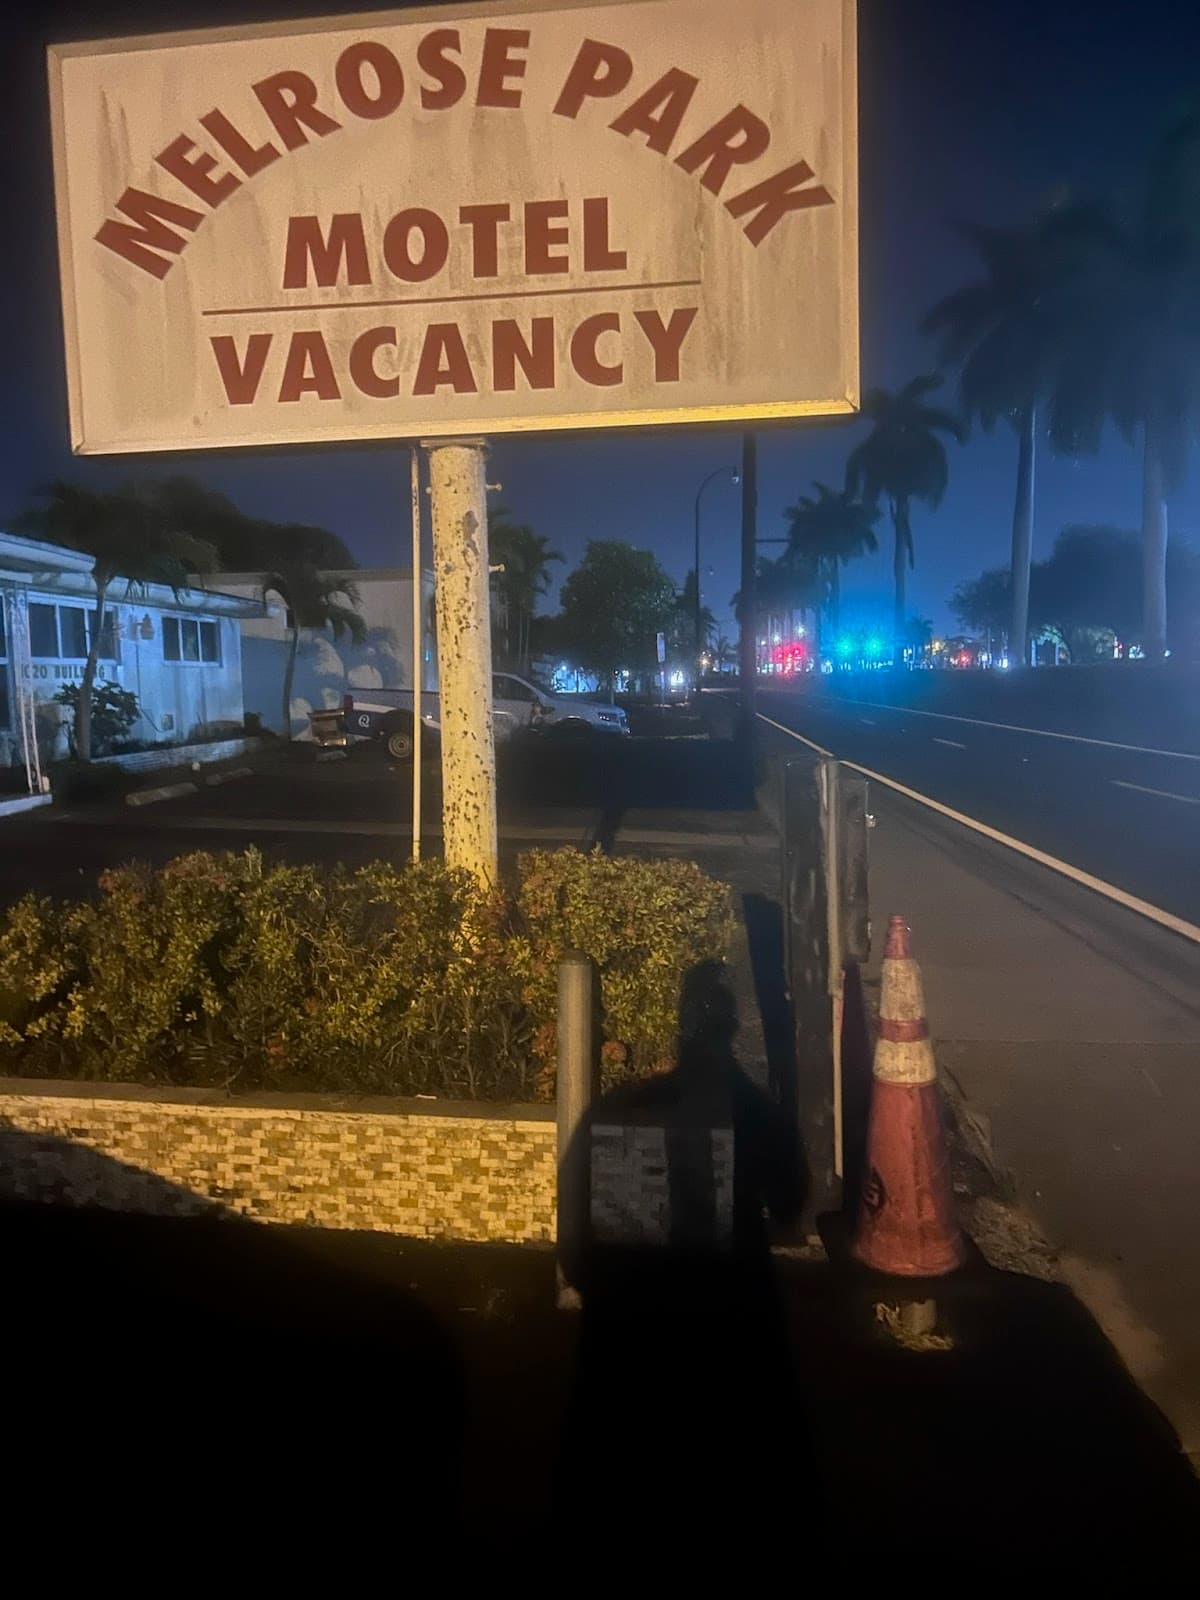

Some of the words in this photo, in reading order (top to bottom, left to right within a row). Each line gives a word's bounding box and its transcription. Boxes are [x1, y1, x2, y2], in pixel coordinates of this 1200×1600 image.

[94, 26, 532, 281] MELROSE
[552, 37, 834, 247] PARK
[282, 196, 628, 290] MOTEL
[210, 306, 699, 406] VACANCY
